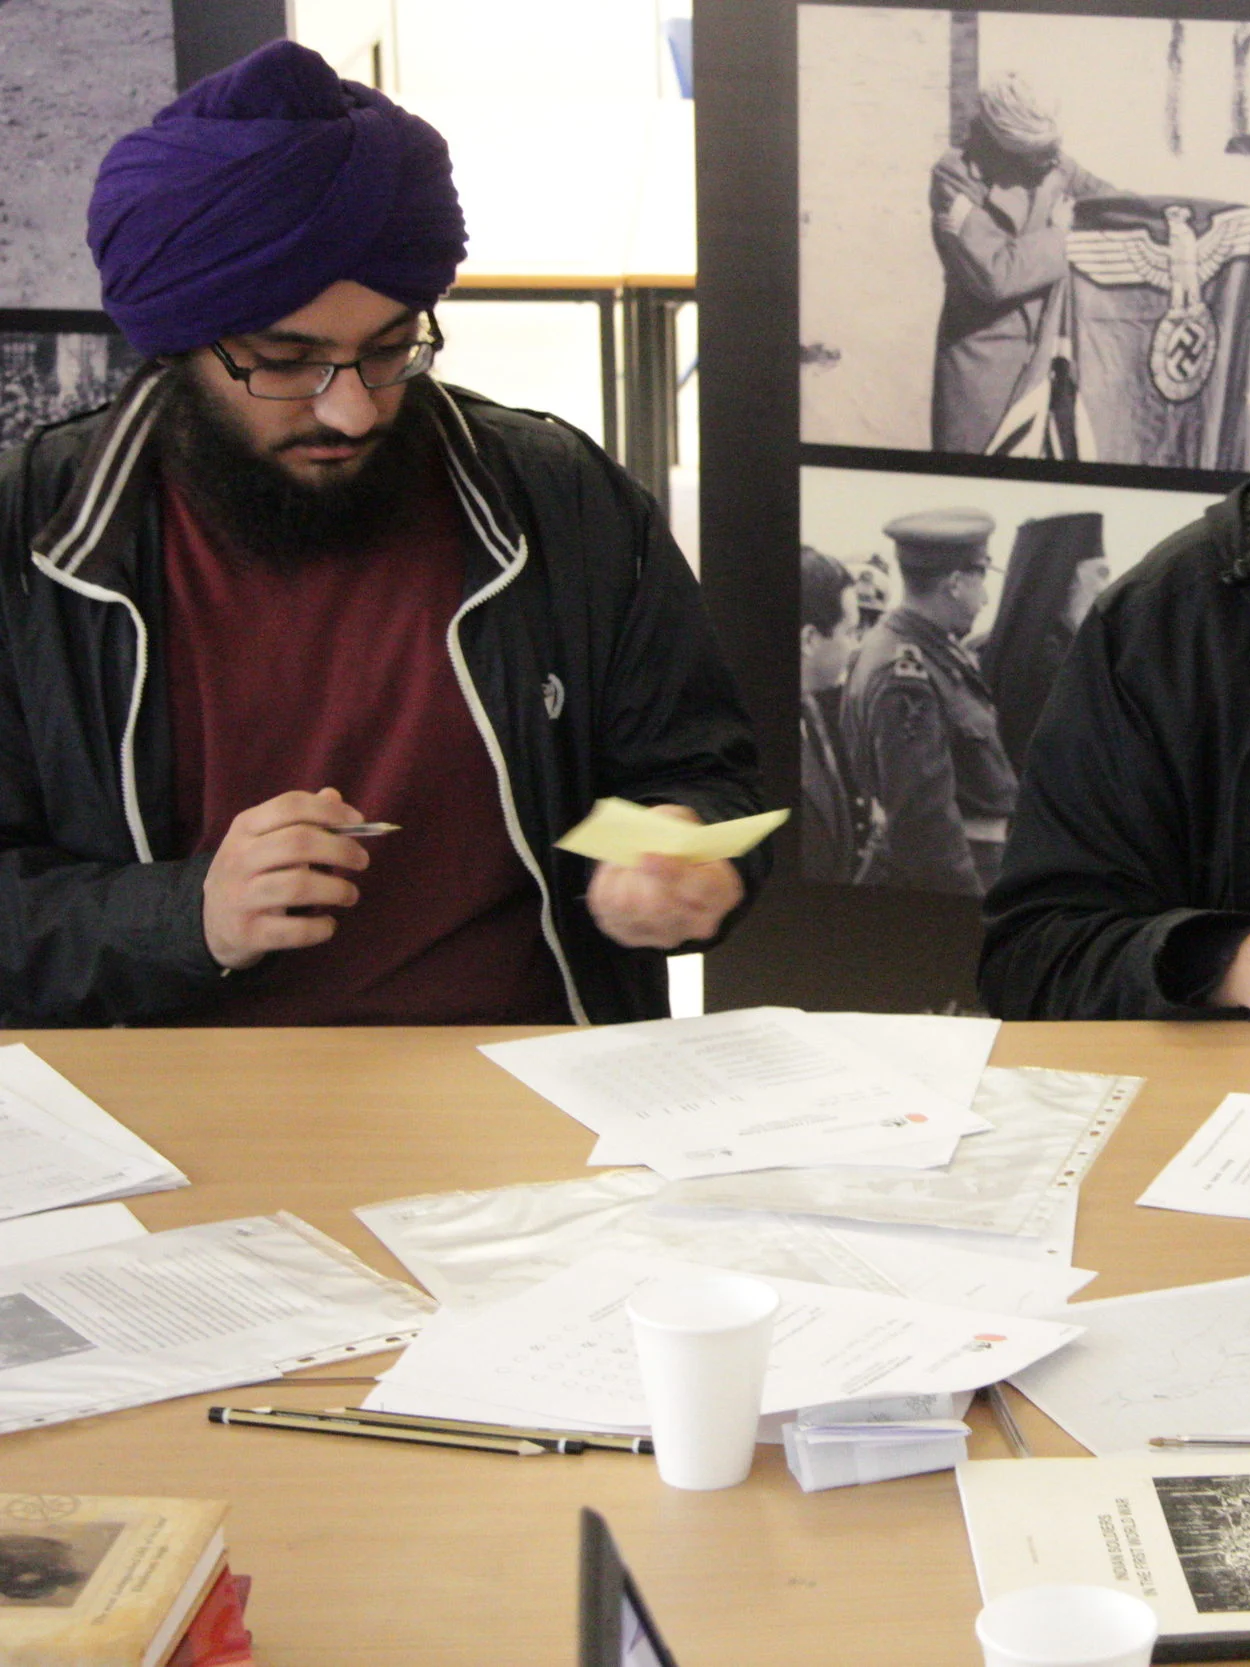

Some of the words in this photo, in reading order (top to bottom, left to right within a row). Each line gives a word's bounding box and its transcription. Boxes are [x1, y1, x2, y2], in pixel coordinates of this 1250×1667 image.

[1114, 1497, 1133, 1516] WAR
[1097, 1514, 1122, 1553] SOLDIERS
[1120, 1517, 1142, 1547] WORLD
[1109, 1553, 1130, 1581] INDIAN
[1128, 1547, 1149, 1570] FIRST
[1136, 1570, 1154, 1587] THE
